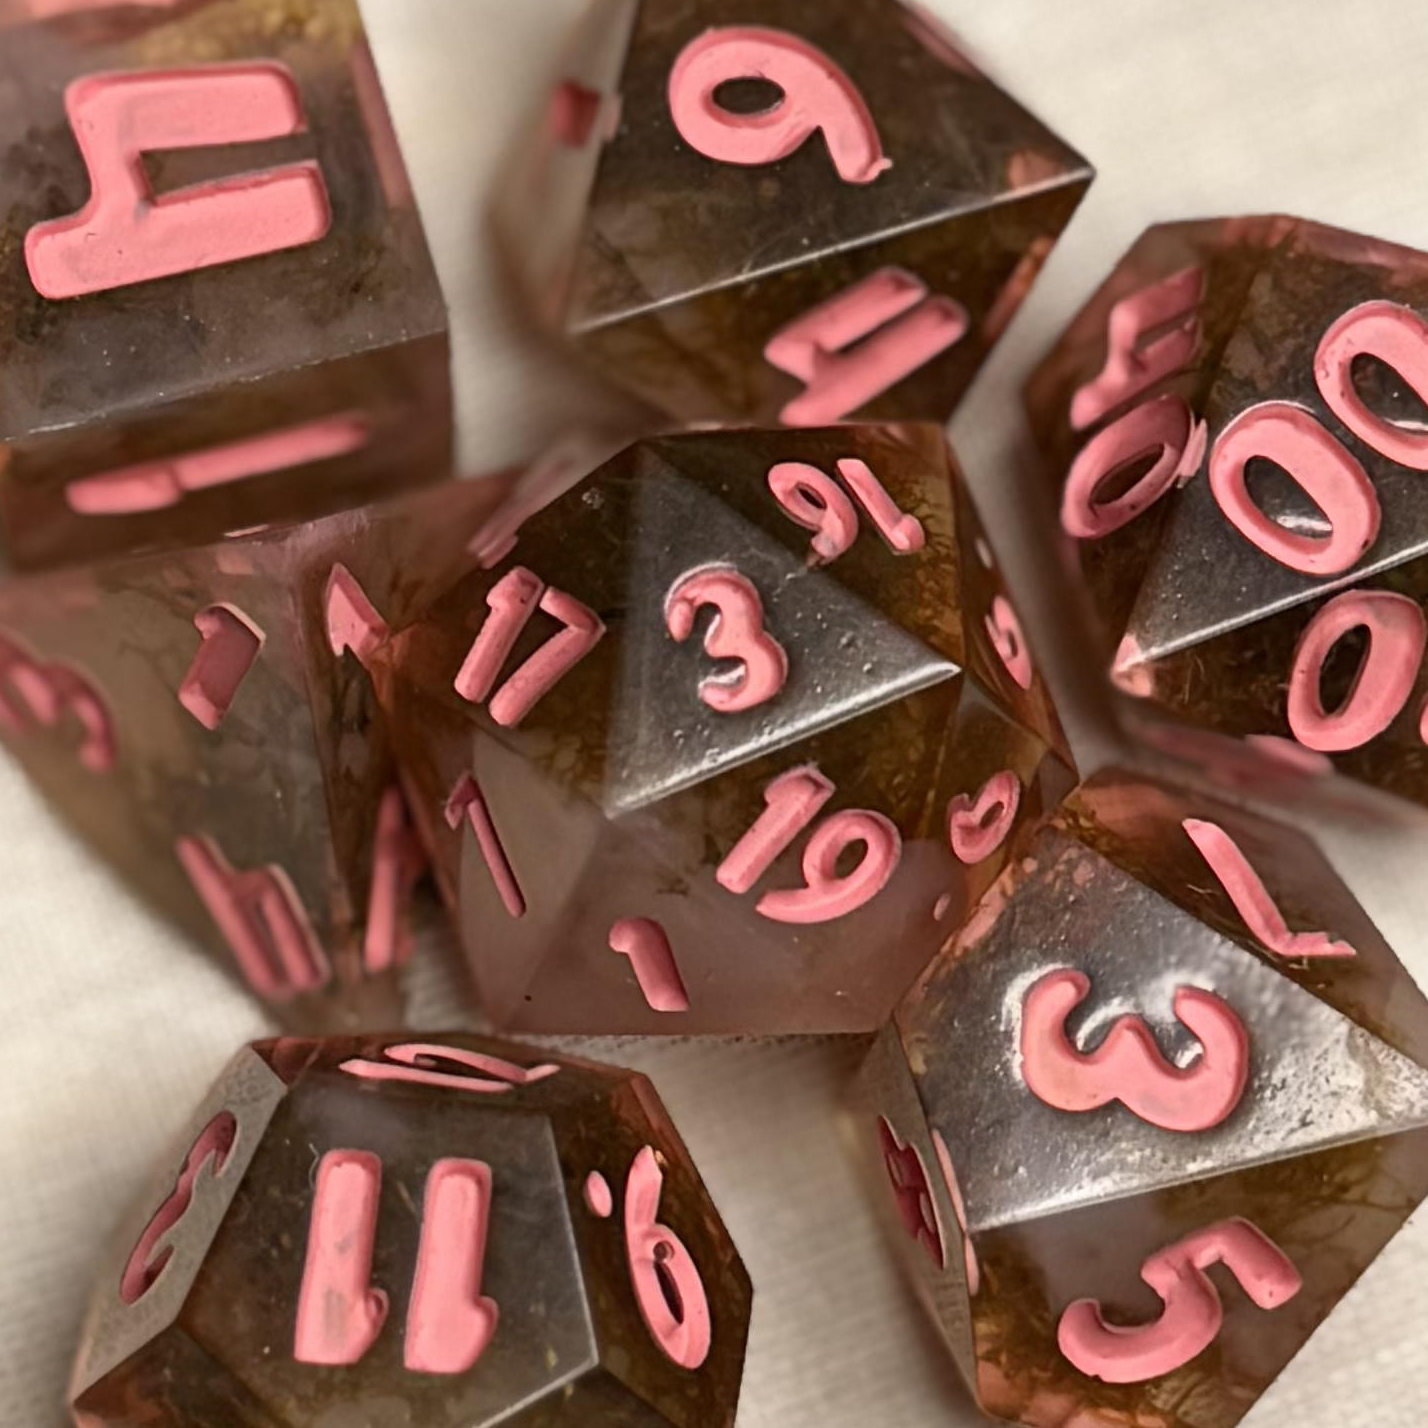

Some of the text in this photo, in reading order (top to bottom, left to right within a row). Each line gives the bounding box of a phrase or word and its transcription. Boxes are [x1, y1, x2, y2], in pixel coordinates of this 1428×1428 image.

[24, 59, 332, 301] 4
[453, 565, 605, 728] 17
[664, 562, 789, 714] 3
[715, 765, 902, 926] 19
[1019, 968, 1250, 1132] 3
[293, 1148, 500, 1375] 11
[1057, 1217, 1302, 1384] 5
